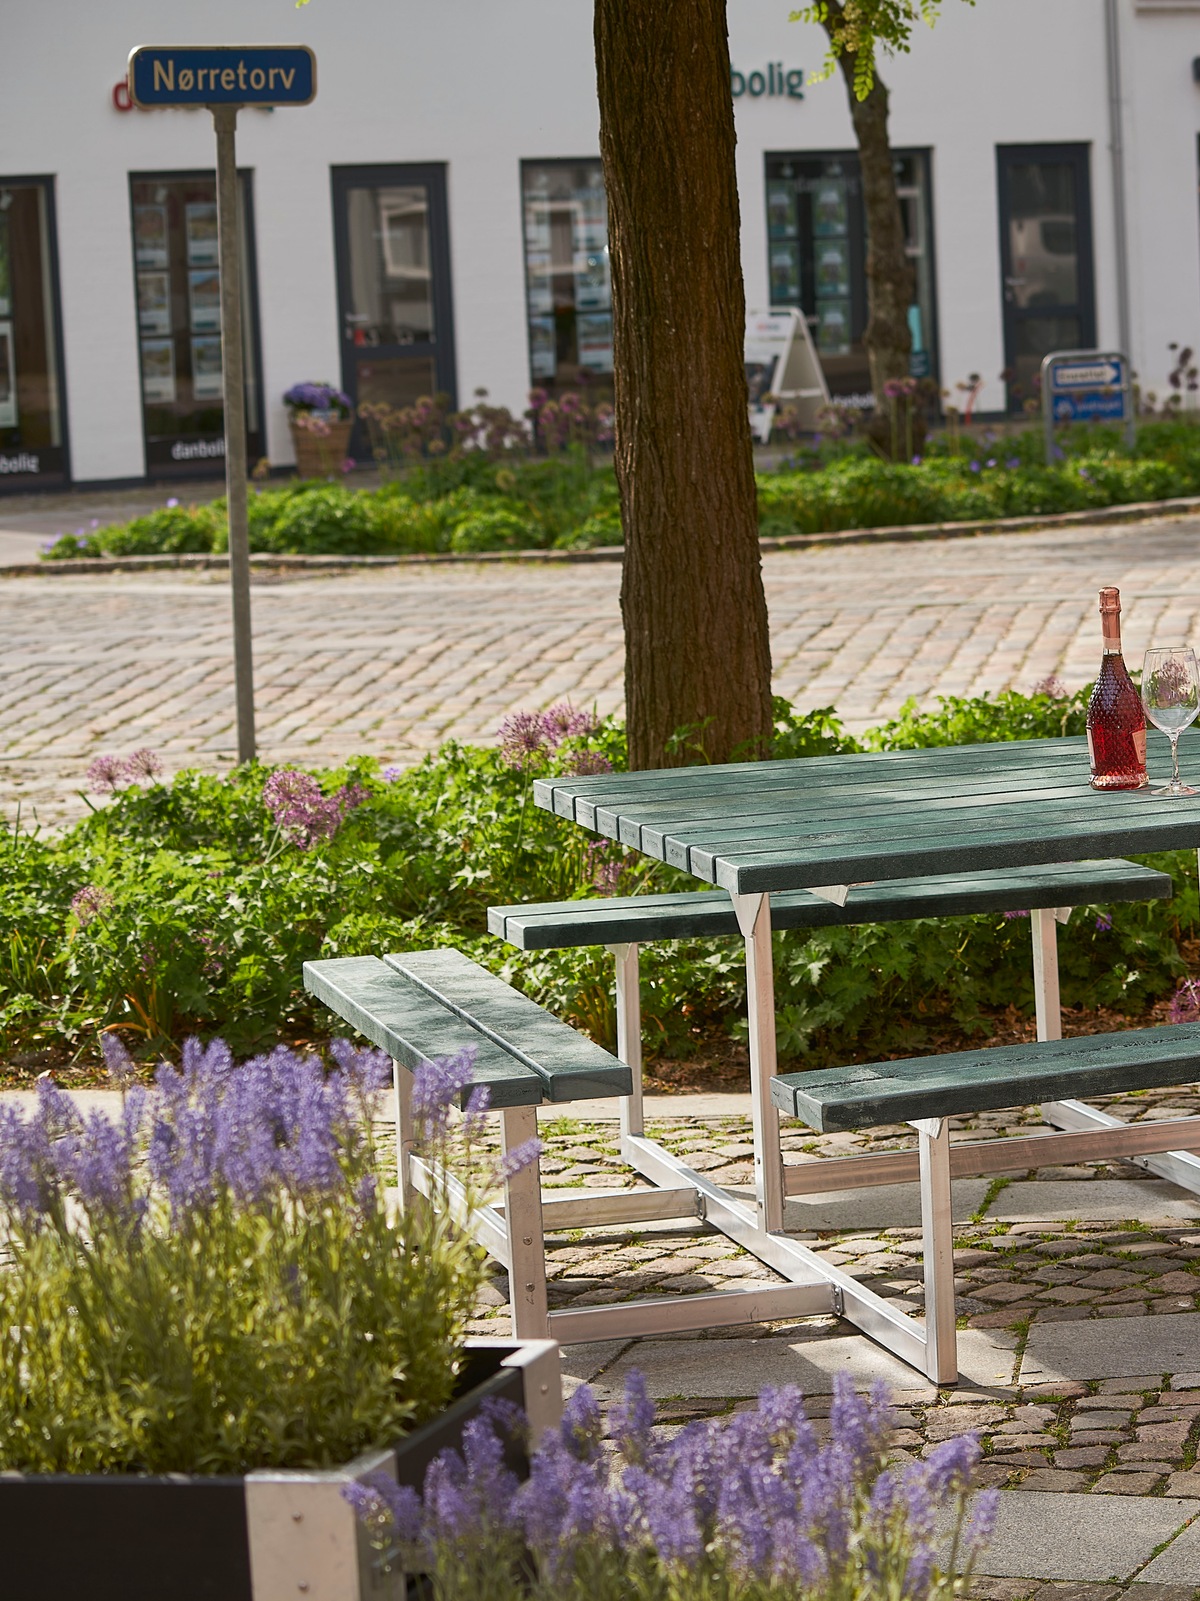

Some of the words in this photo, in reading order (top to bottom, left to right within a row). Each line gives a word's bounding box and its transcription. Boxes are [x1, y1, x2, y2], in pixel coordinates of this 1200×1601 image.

[153, 59, 296, 91] Nørretorv
[730, 62, 804, 100] bolig
[171, 438, 225, 460] danboli
[0, 452, 40, 474] bolig
